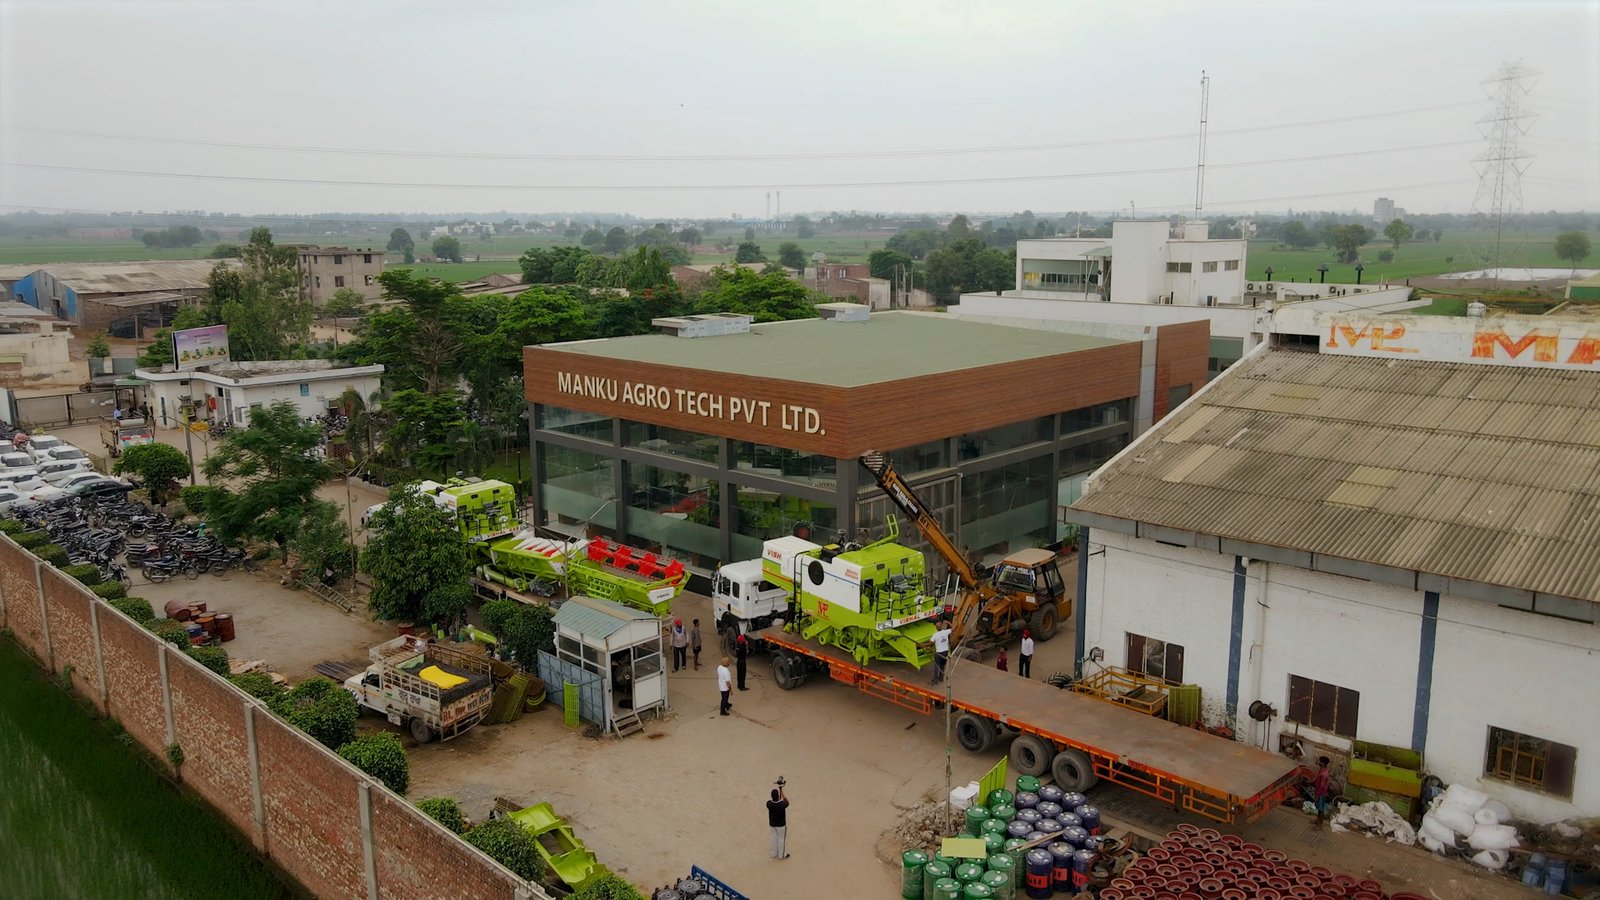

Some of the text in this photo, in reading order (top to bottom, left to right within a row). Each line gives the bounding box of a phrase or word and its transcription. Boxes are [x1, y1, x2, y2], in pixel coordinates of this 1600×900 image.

[558, 371, 827, 435] MANKU AGRO TECH PVT LTD.
